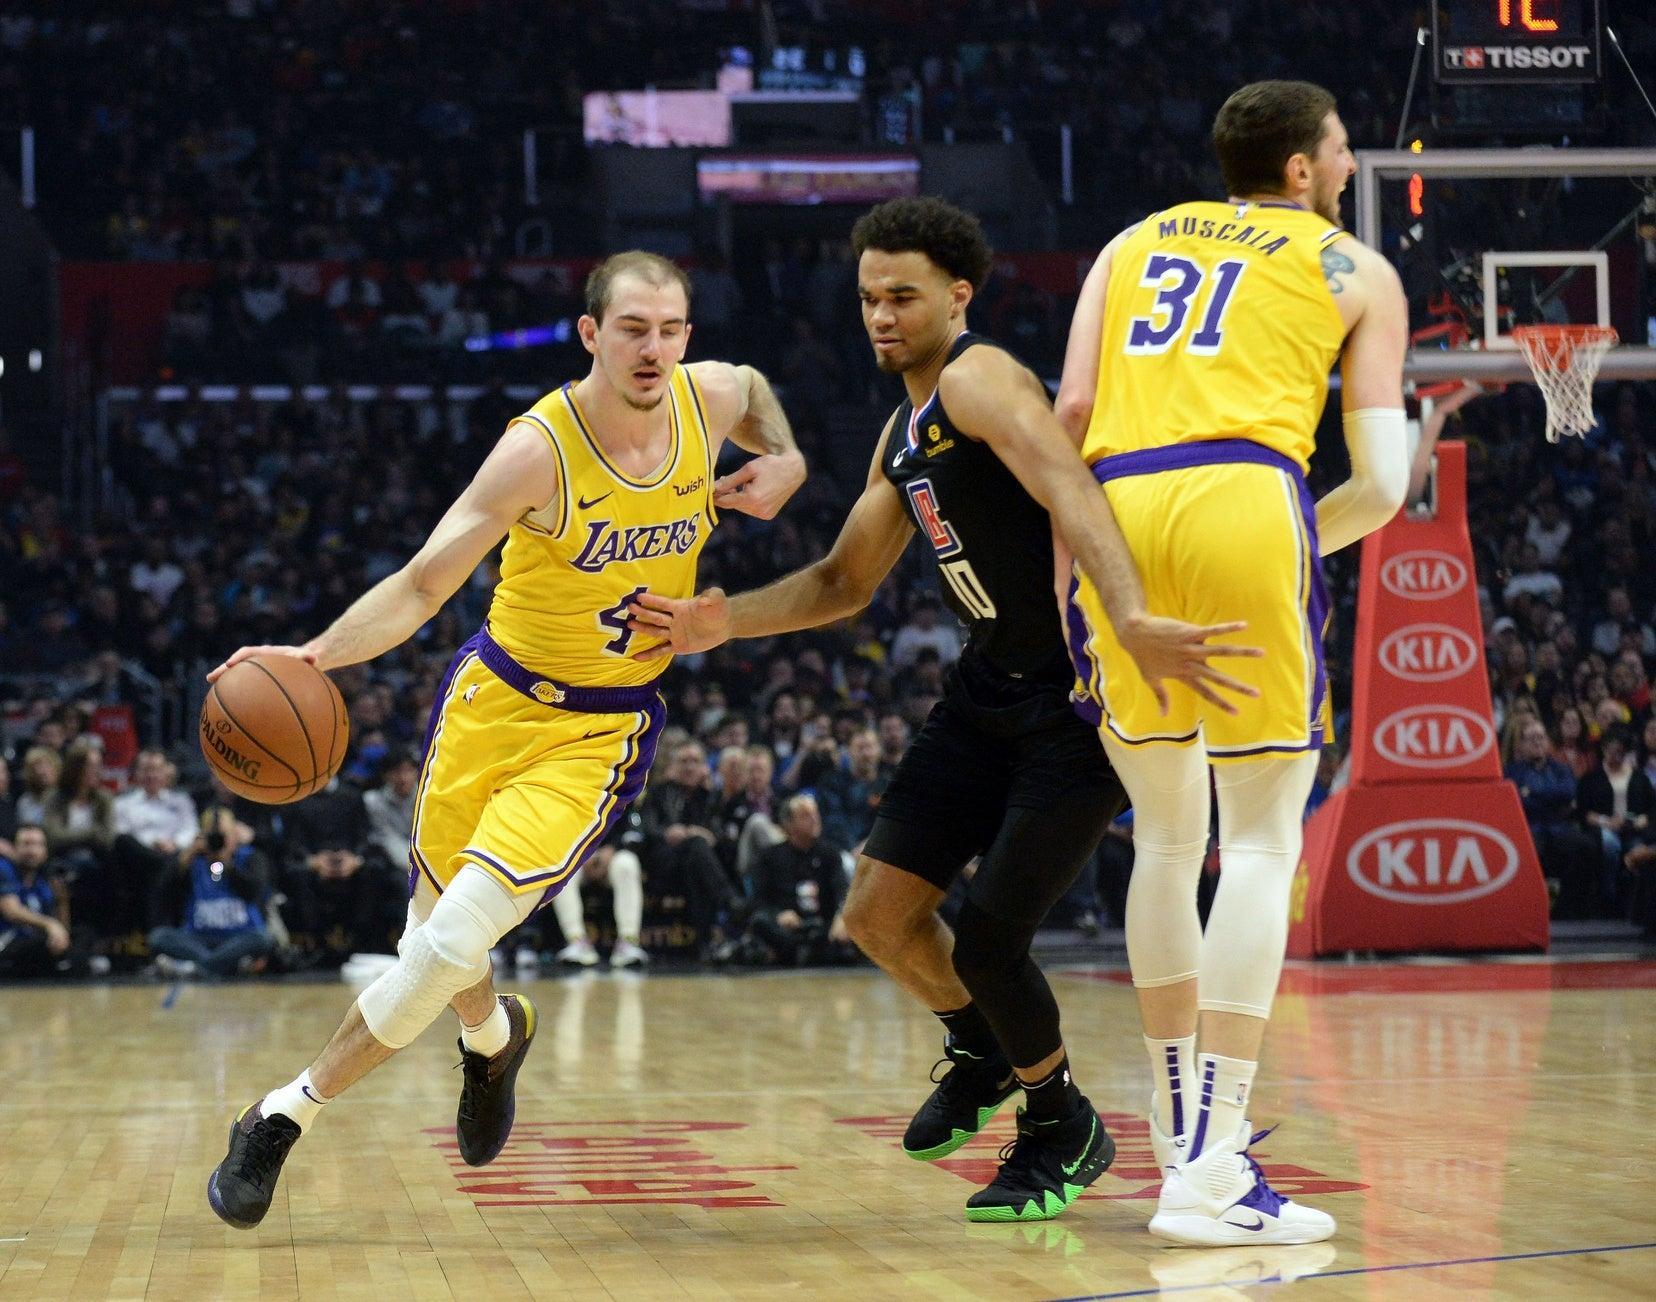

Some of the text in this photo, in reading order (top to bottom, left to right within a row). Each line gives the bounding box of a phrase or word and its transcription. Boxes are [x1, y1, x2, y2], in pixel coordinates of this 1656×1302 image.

[1484, 46, 1590, 69] TISSOT
[1123, 253, 1248, 357] 31
[673, 475, 704, 496] wish
[567, 511, 701, 574] LAKERS
[939, 559, 997, 619] 10
[1395, 561, 1455, 590] KIA
[597, 586, 648, 658] 4
[1395, 636, 1464, 671] KIA
[201, 700, 261, 779] PALDING
[1394, 719, 1476, 754] KIA
[1376, 837, 1490, 886] KIA
